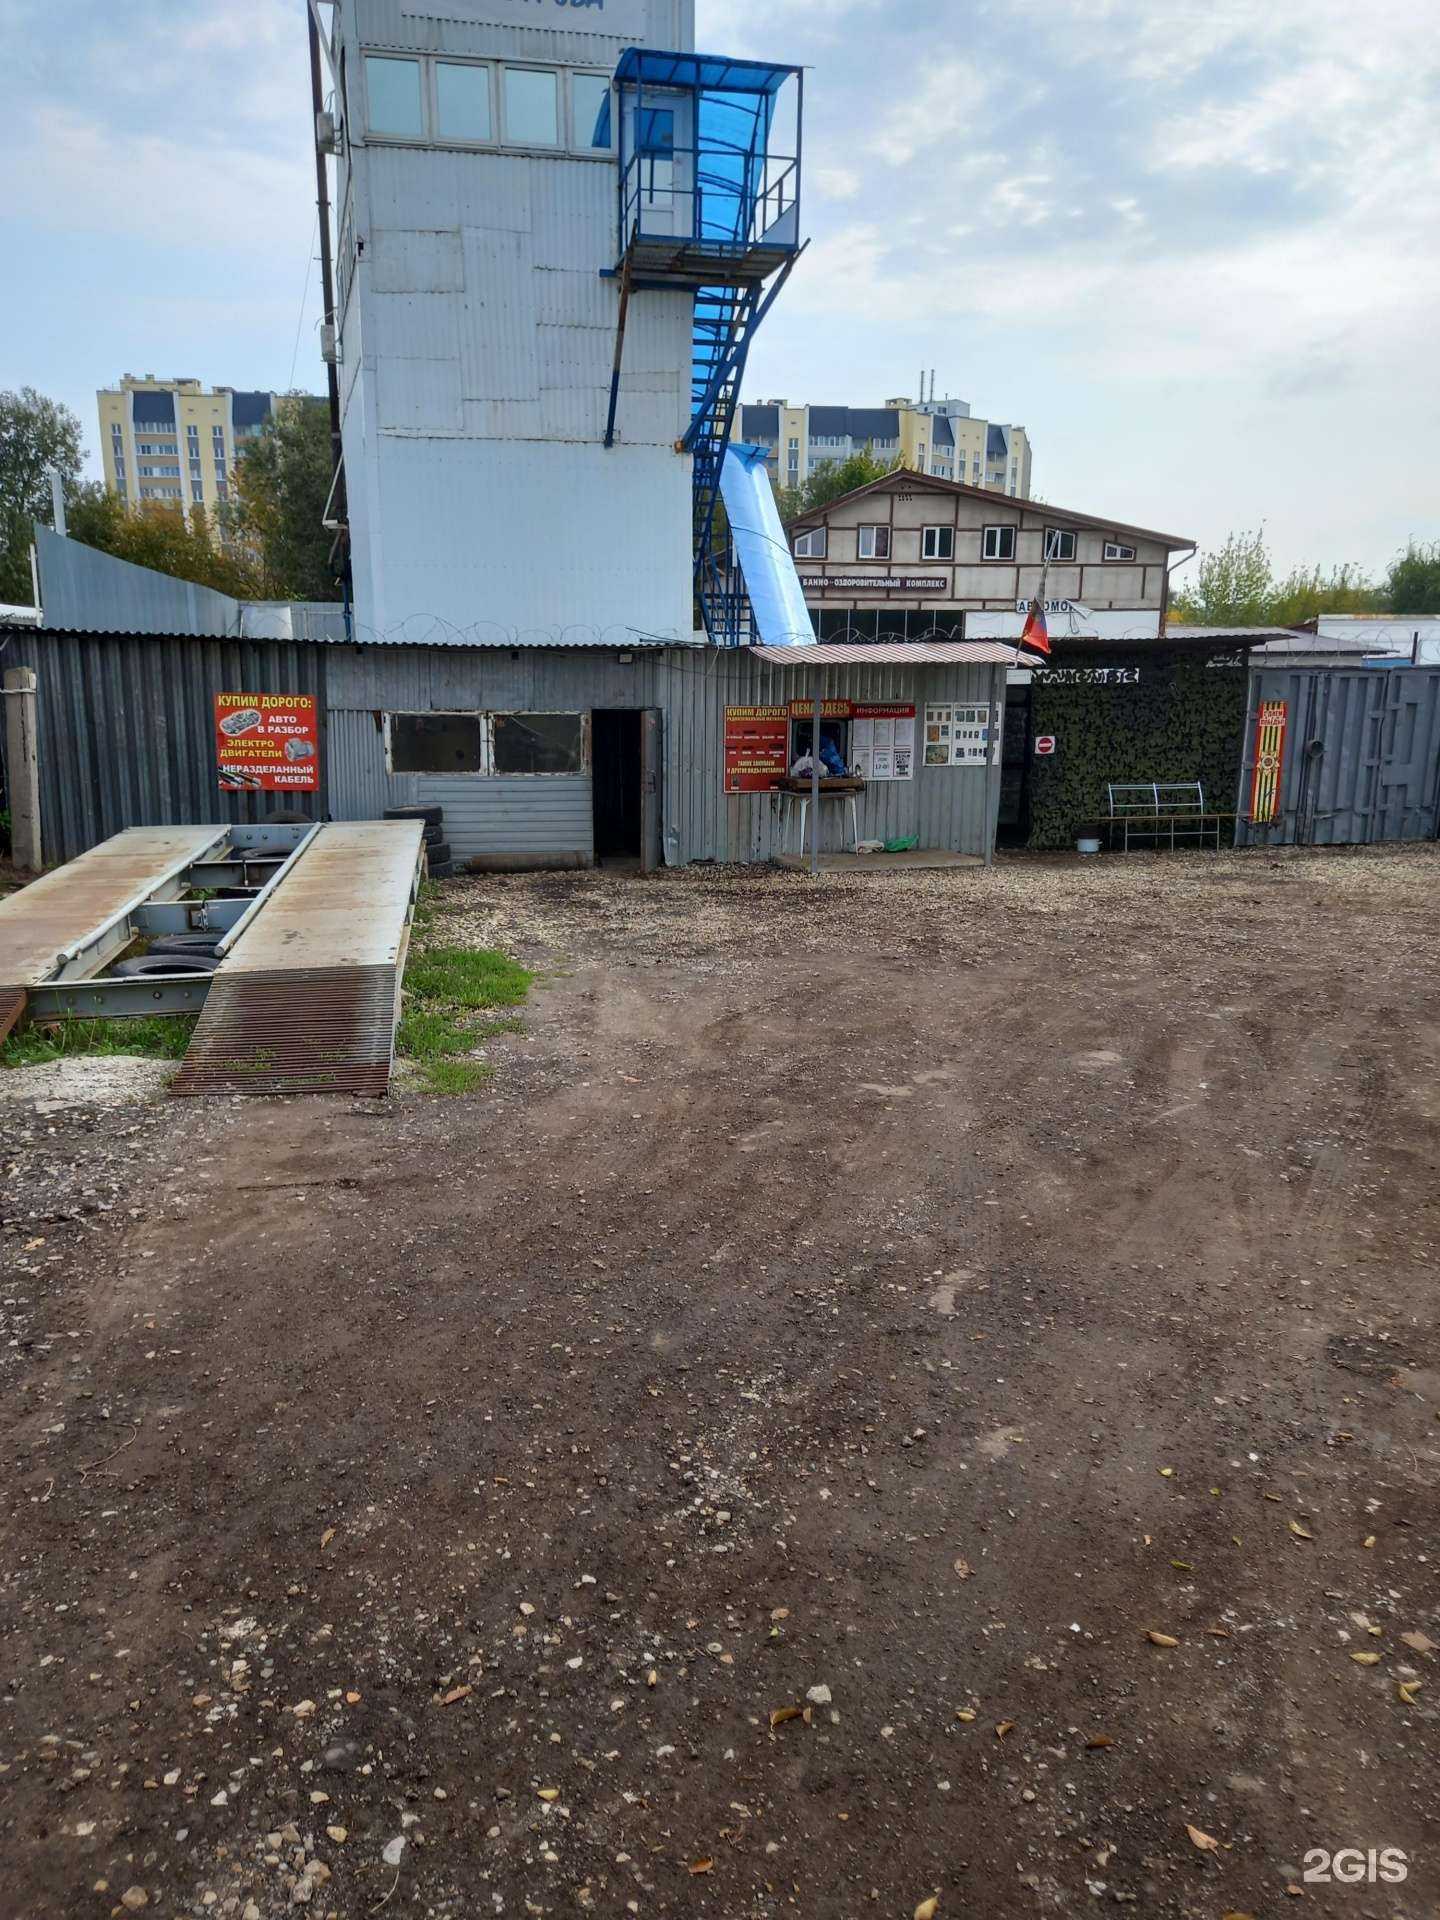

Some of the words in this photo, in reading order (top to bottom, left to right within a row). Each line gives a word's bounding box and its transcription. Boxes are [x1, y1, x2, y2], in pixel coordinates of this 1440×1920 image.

[906, 579, 945, 588] КОМПЛЕКС
[218, 695, 259, 708] КУПИМ
[261, 696, 313, 709] ДОРОГО:
[727, 707, 754, 717] КУПИМ
[756, 708, 787, 717] ДОРОГО
[268, 715, 297, 724] АВТО
[257, 726, 265, 734] В
[267, 726, 309, 735] РАЗБОР
[226, 739, 275, 748] ЭЛЕКТРО
[220, 749, 282, 759] ДВИГАТЕЛИ
[222, 764, 314, 774] НЕРАЗДЕЛАННЫЙ
[274, 775, 314, 784] КАБЕЛЬ
